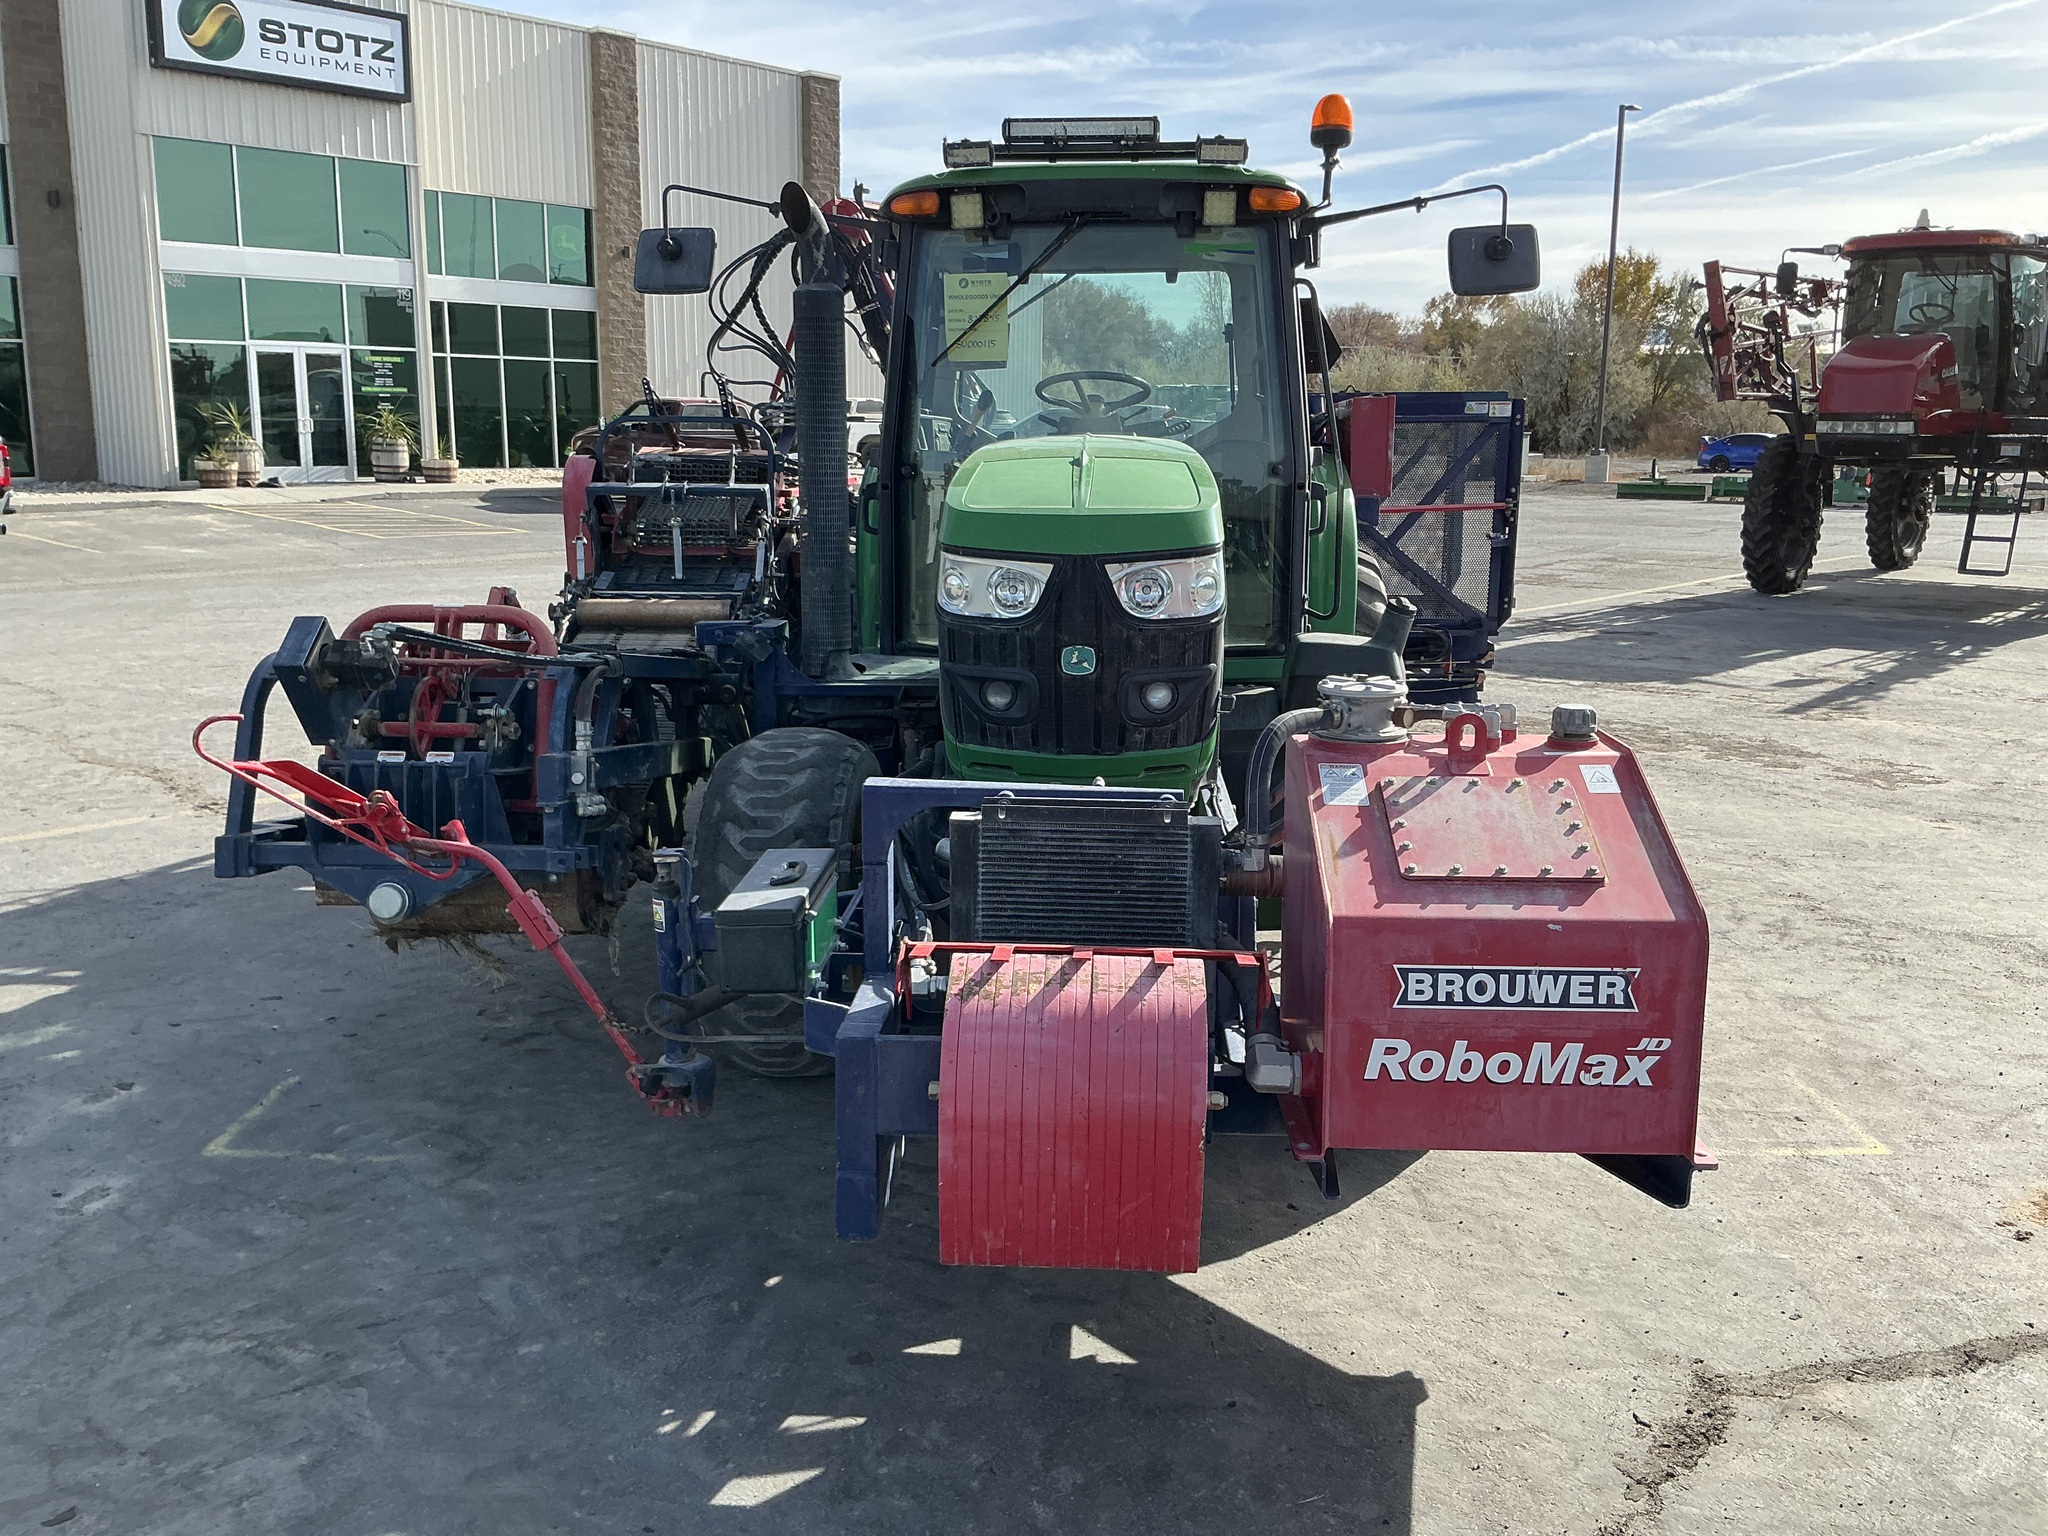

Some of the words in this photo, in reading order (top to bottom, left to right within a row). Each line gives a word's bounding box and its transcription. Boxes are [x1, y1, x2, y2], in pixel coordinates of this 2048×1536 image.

[258, 18, 396, 64] STOTZ
[260, 47, 396, 79] EQUIPMENT
[396, 288, 412, 301] 119
[1407, 972, 1626, 1005] BROUWER
[1363, 1038, 1661, 1087] RoboMax
[1626, 1037, 1672, 1051] JD
